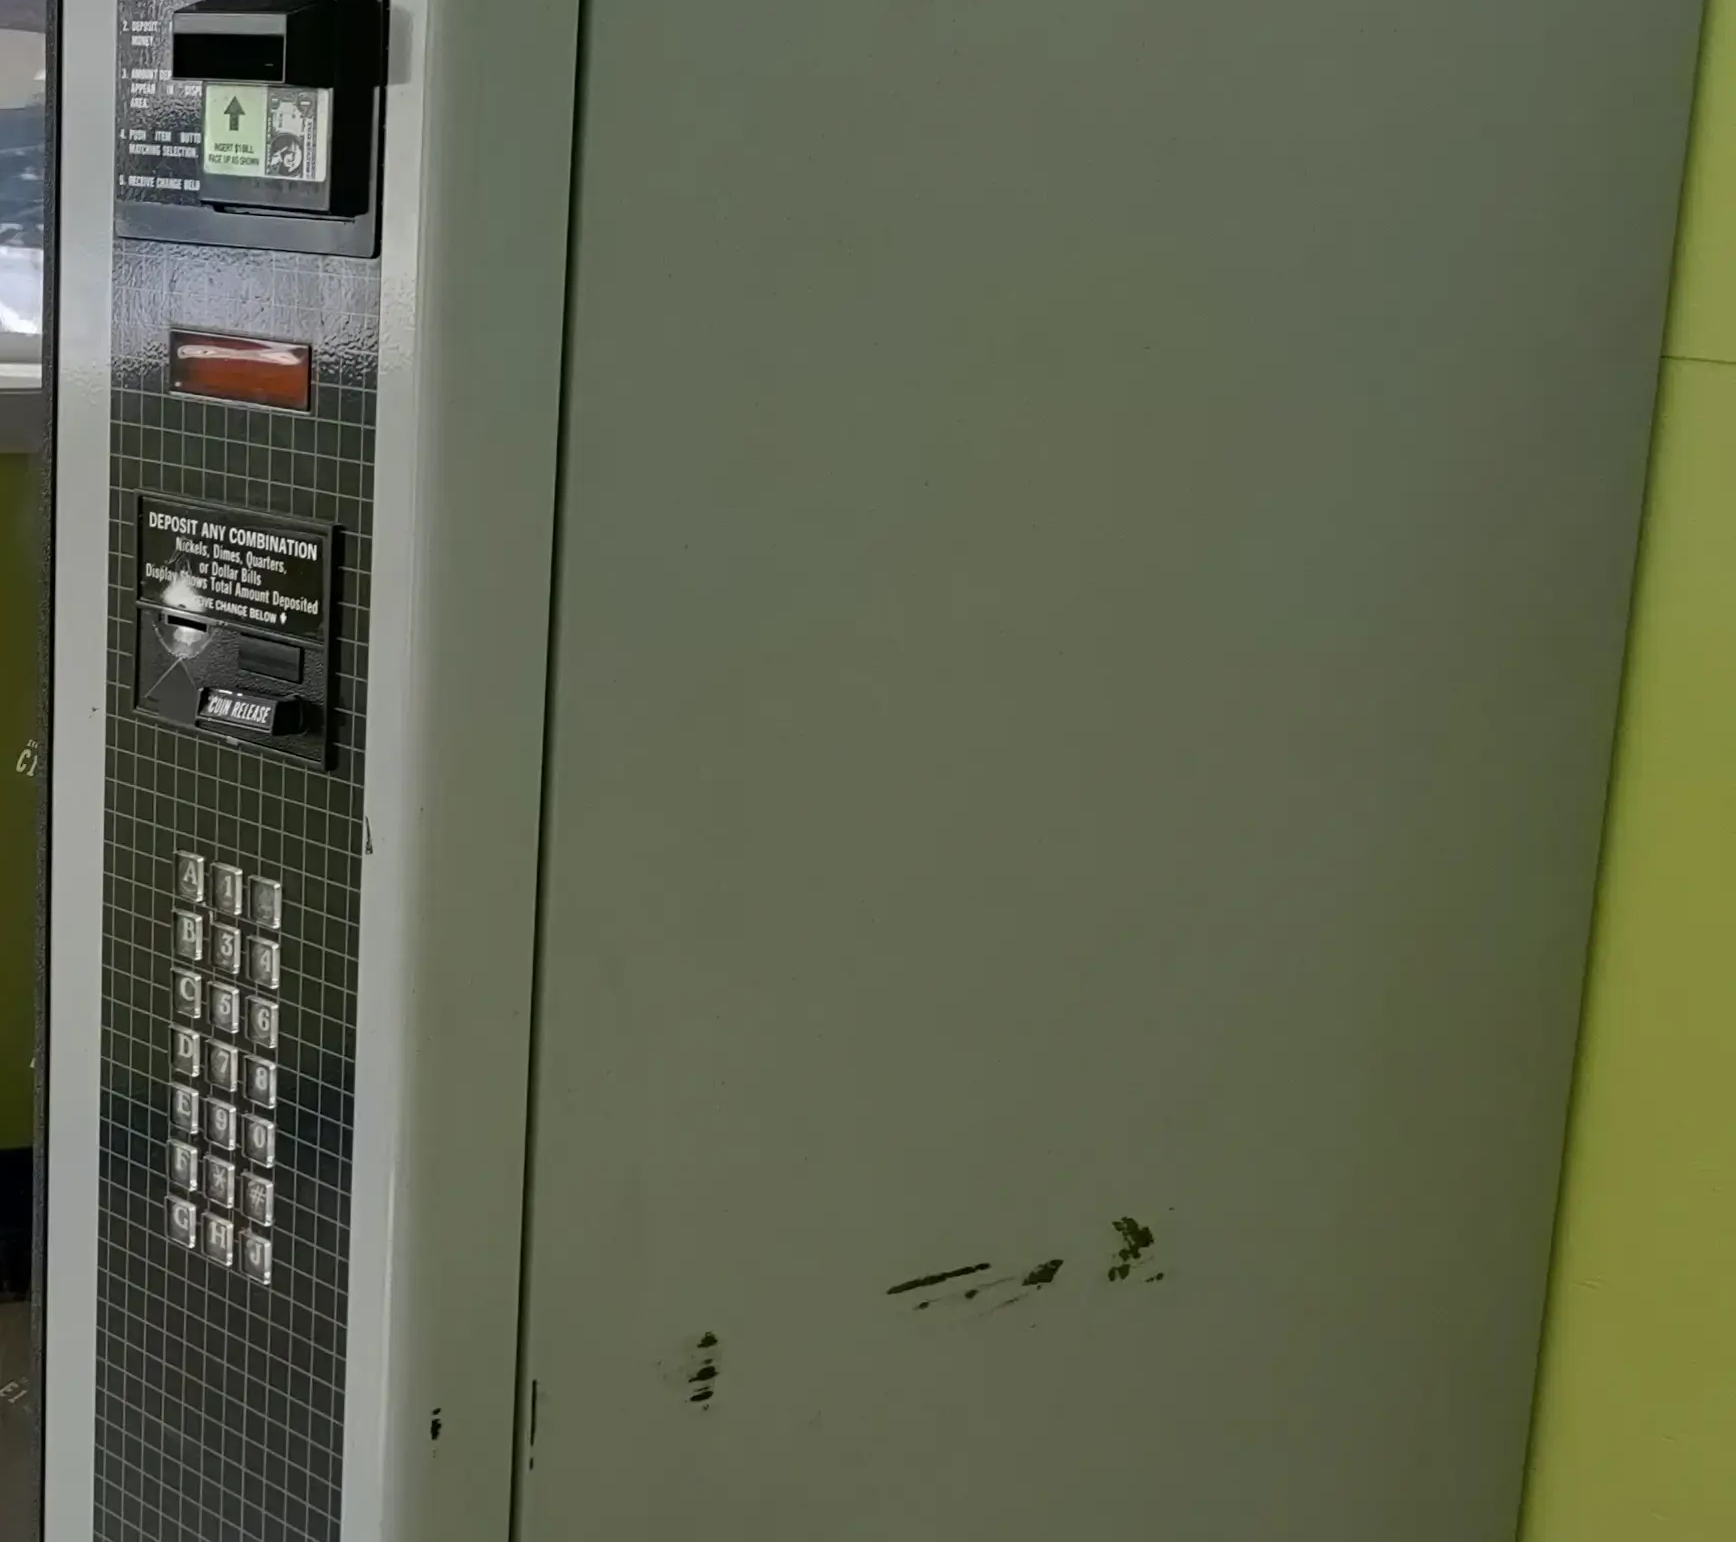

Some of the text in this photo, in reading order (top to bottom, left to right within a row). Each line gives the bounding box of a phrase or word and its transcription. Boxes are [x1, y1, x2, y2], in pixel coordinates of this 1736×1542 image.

[180, 132, 202, 144] BUTTO
[156, 177, 182, 190] CHANGE
[184, 179, 200, 191] BELO
[149, 511, 318, 561] DEPOSIT ANY COMBINATION
[145, 562, 179, 586] Display
[210, 576, 233, 596] Total
[235, 582, 270, 604] Amount
[272, 590, 319, 615] Deposited
[199, 561, 262, 587] or Dollar Bills
[215, 599, 249, 617] CHANGE
[249, 607, 277, 624] BELOW
[207, 696, 272, 723] COIN RELEASE
[183, 861, 233, 897] A 1
[182, 916, 272, 973] B 3 4
[179, 977, 270, 1032] C 5 6
[178, 1032, 268, 1091] D 7 8
[176, 1089, 265, 1149] E 9 0
[175, 1146, 190, 1170] F
[173, 1206, 263, 1266] G H J
